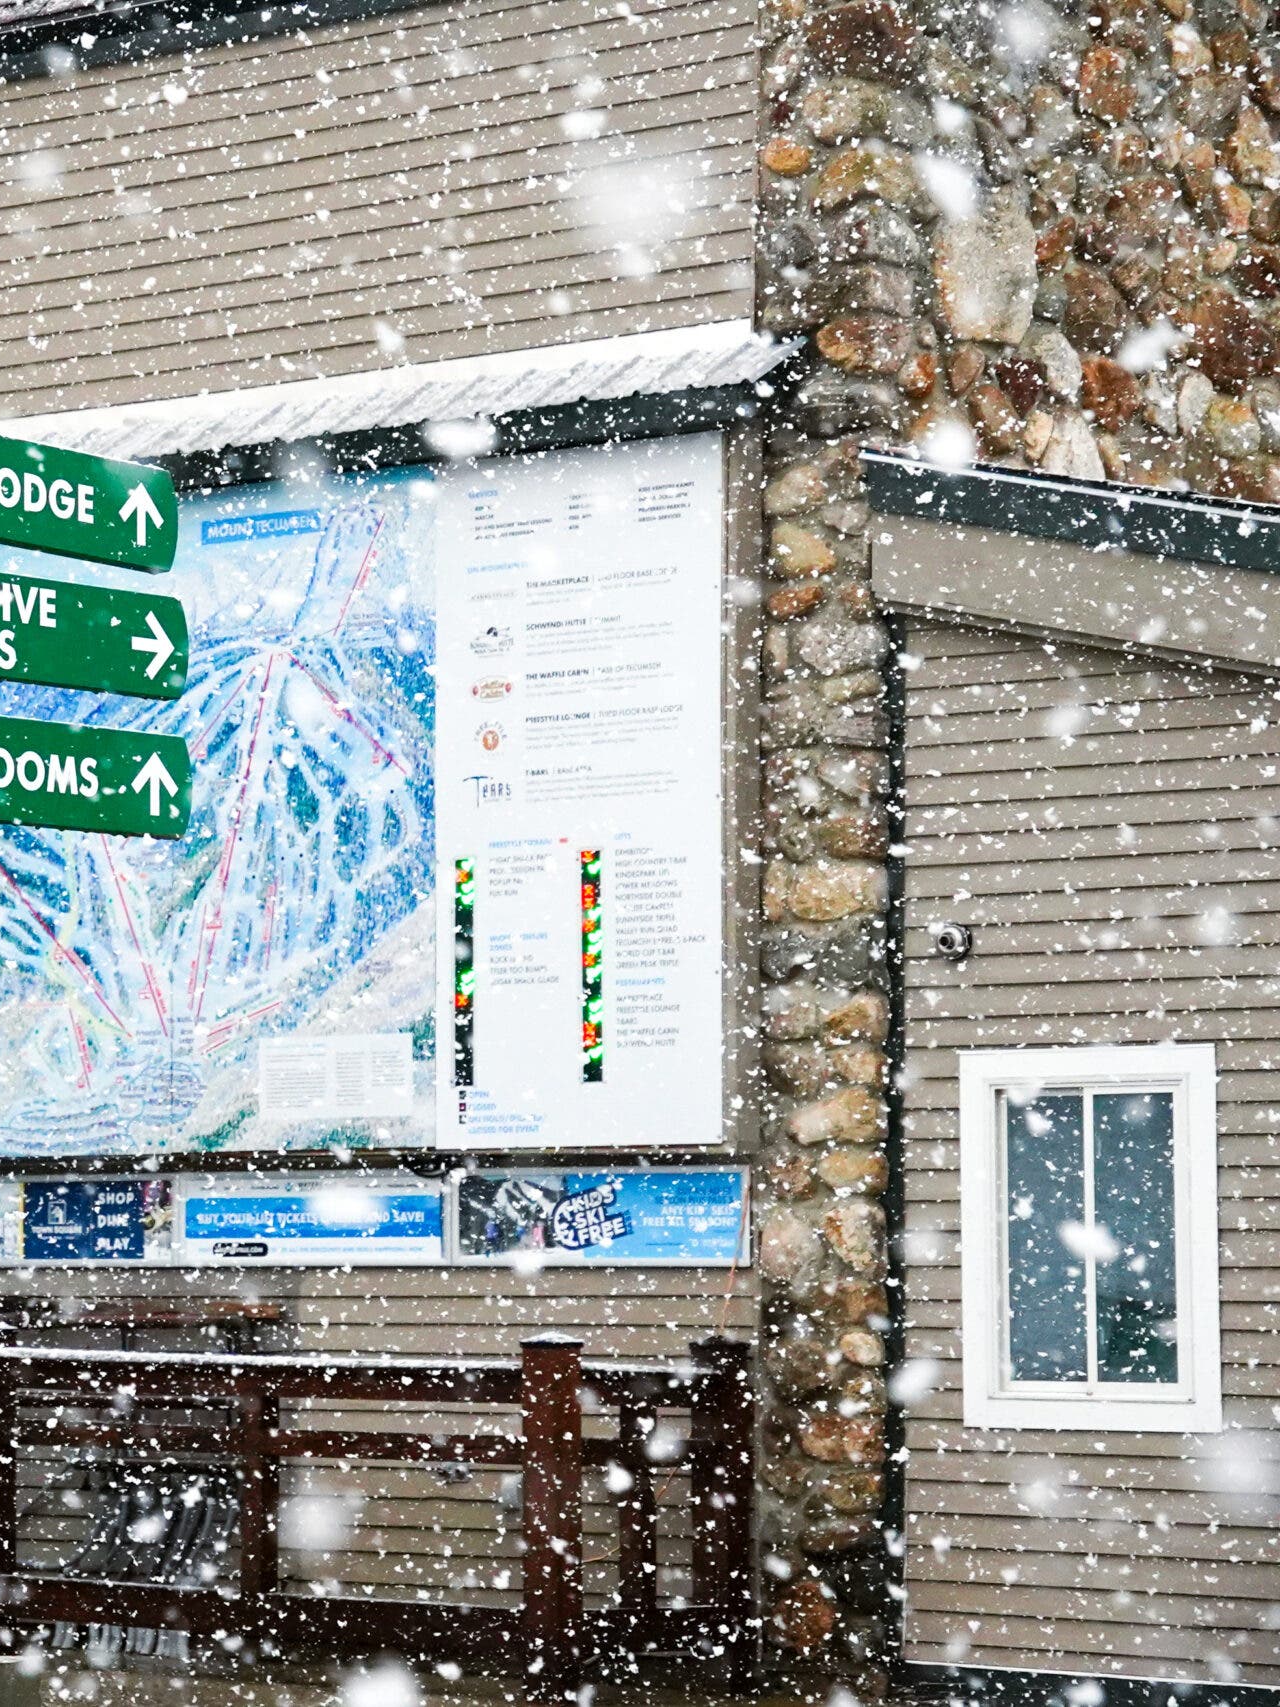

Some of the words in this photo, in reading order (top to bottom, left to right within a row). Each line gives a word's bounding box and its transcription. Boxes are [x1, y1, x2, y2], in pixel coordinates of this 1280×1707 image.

[98, 1192, 135, 1205] SHOP
[575, 1207, 605, 1229] SKI
[642, 1216, 665, 1227] FREE
[578, 1217, 626, 1246] FREE
[96, 1237, 130, 1250] PLAY
